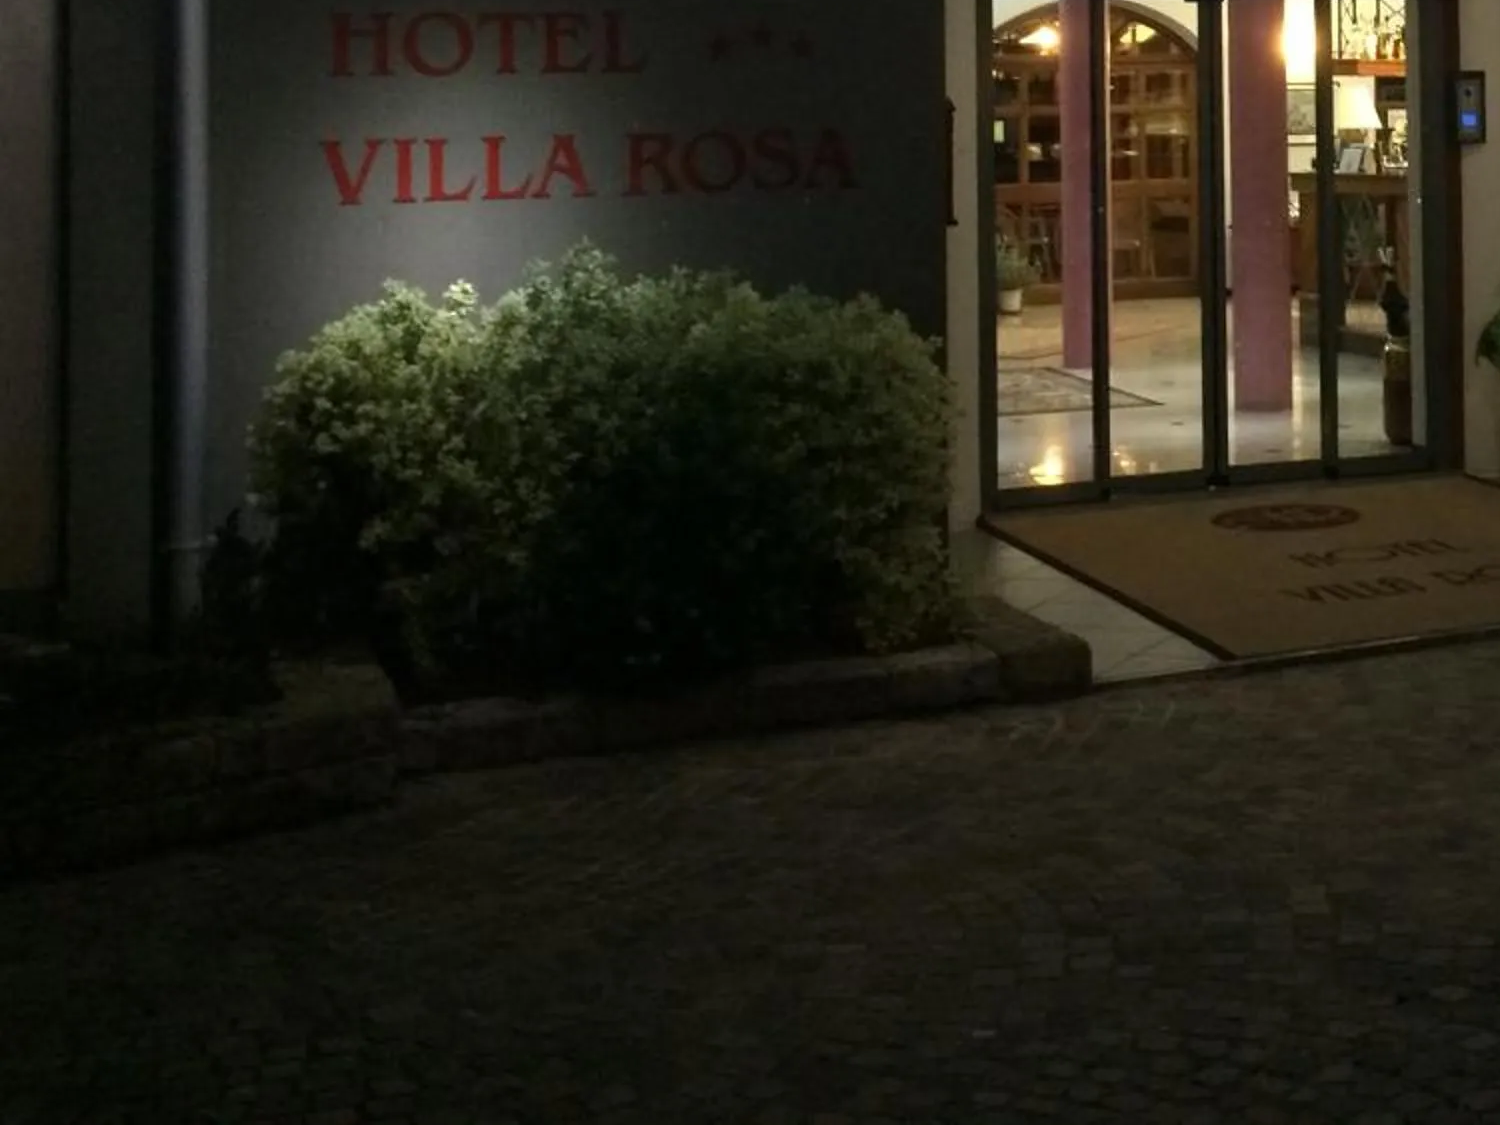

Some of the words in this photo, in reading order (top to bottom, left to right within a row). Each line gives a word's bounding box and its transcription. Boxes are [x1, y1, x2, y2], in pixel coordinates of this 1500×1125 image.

[329, 9, 646, 78] HOTEL
[318, 133, 597, 207] VILLA
[620, 126, 861, 197] ROSA
